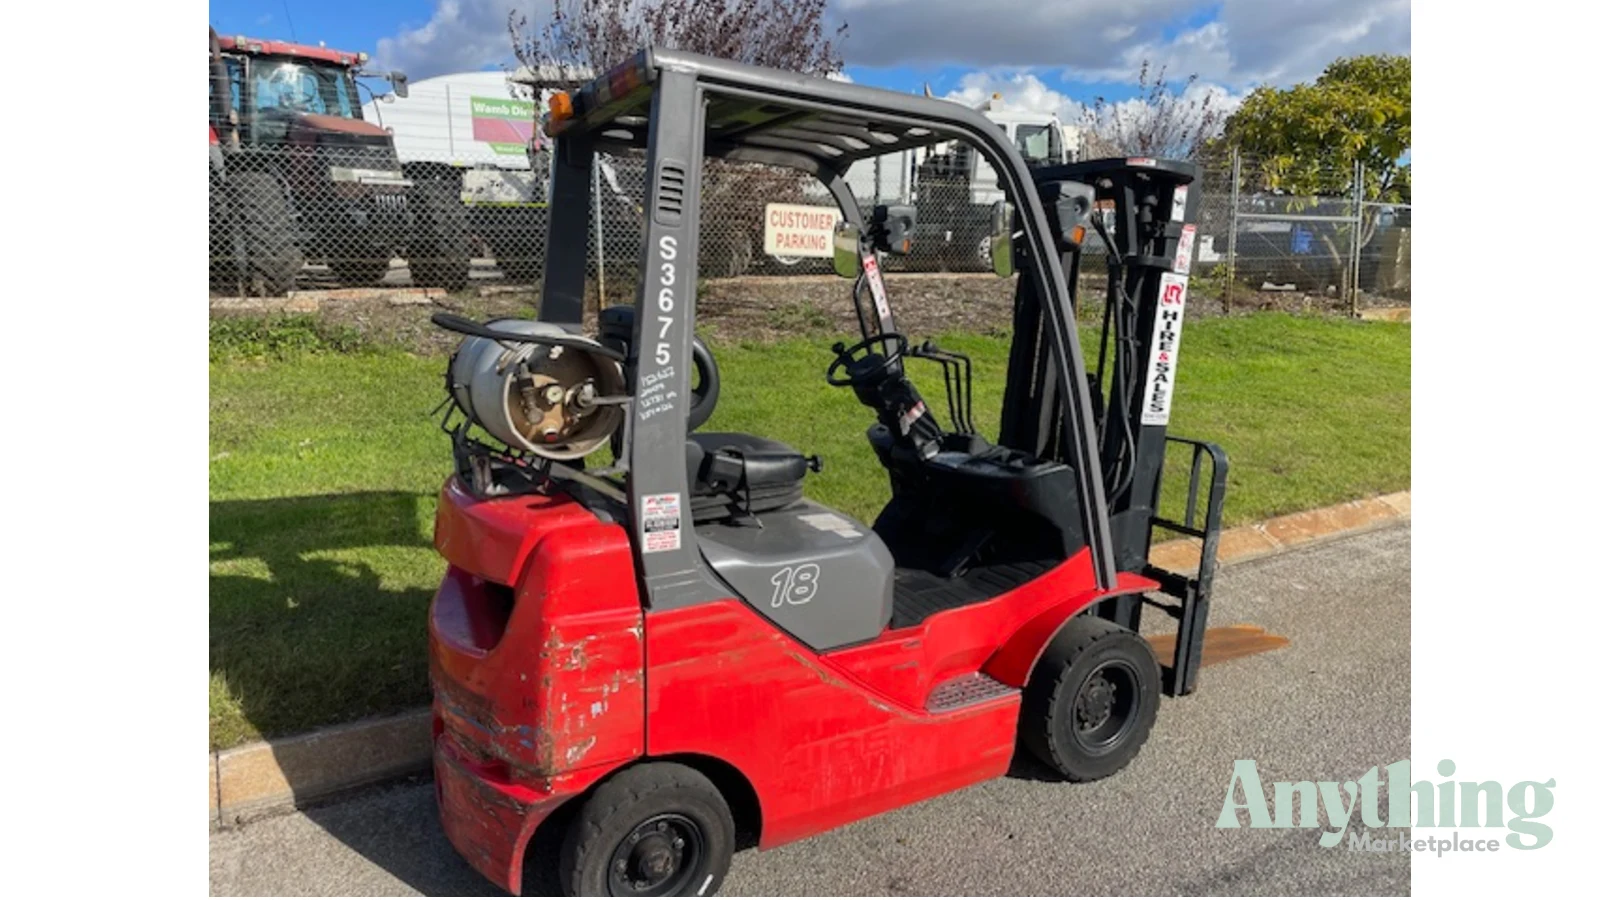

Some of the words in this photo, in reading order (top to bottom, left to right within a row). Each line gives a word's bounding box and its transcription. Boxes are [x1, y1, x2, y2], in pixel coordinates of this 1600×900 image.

[770, 210, 833, 230] CUSTOMER
[775, 232, 826, 250] PARKING
[655, 235, 678, 366] S3675
[771, 563, 820, 608] 18
